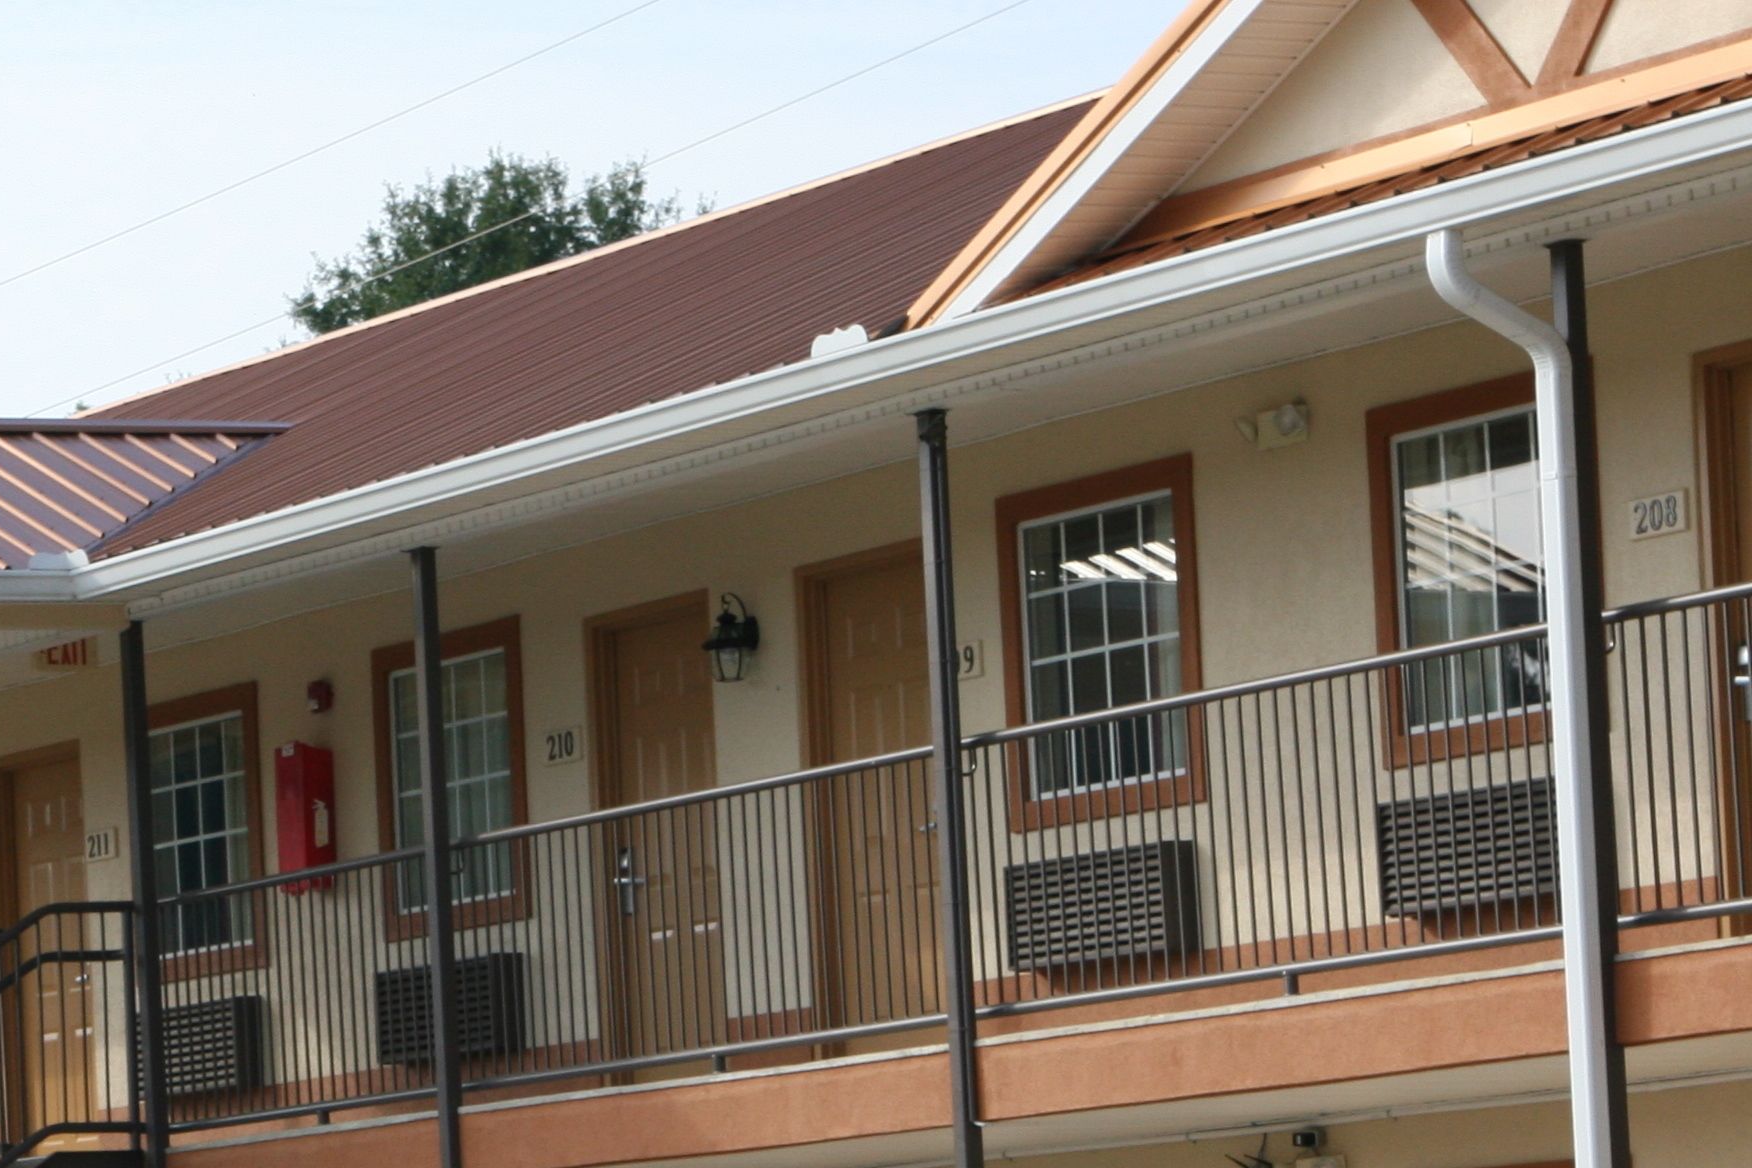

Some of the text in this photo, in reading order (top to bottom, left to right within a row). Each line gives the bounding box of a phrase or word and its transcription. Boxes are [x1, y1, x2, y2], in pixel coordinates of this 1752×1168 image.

[1633, 494, 1678, 535] 208
[546, 731, 574, 761] 210
[87, 832, 109, 858] 211
